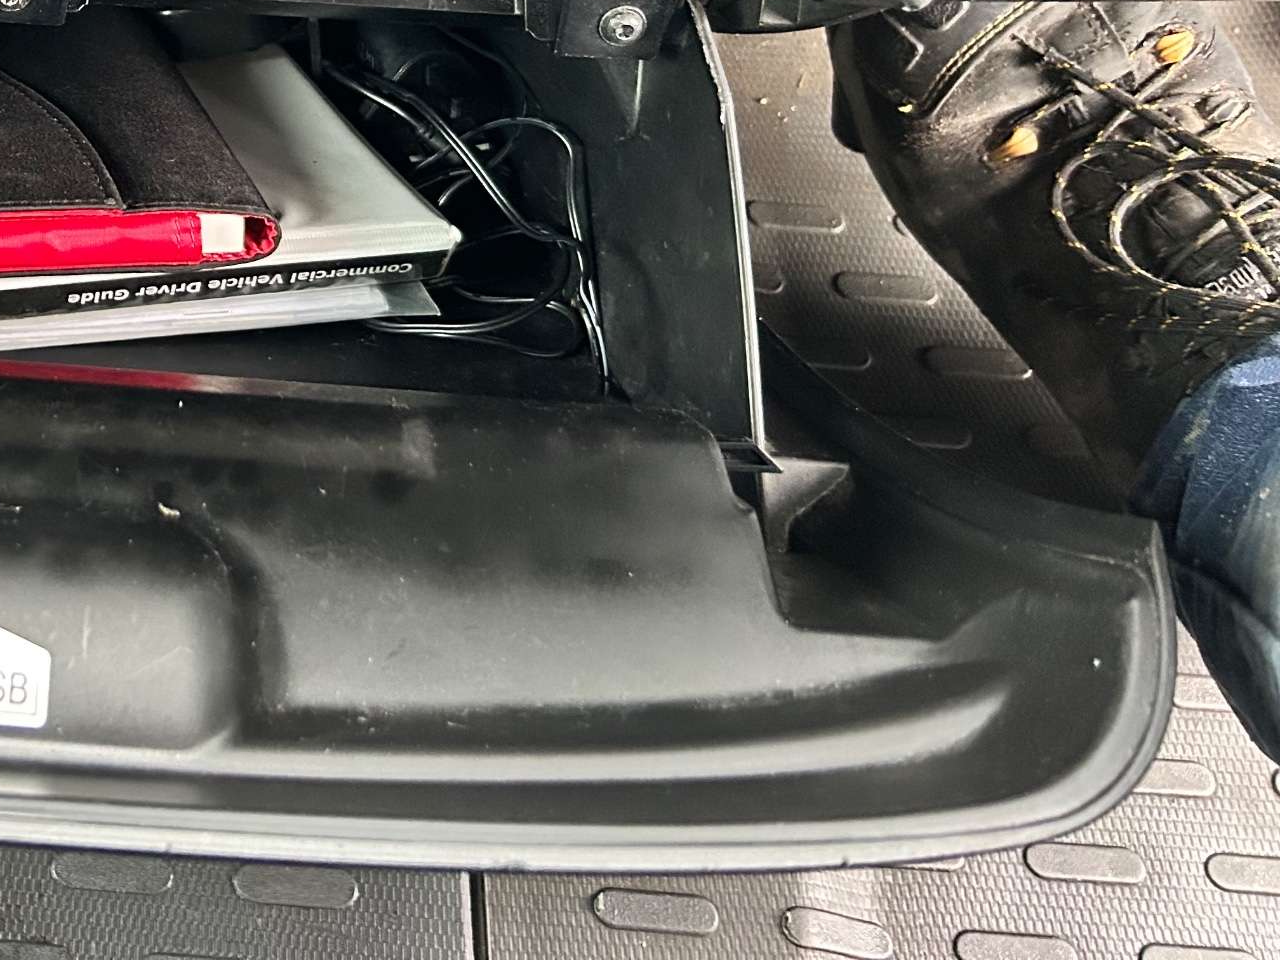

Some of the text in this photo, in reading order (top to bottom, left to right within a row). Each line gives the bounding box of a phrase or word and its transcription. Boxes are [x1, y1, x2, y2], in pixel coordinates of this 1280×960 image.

[67, 263, 413, 305] Commercial Vehicle Driver Guide
